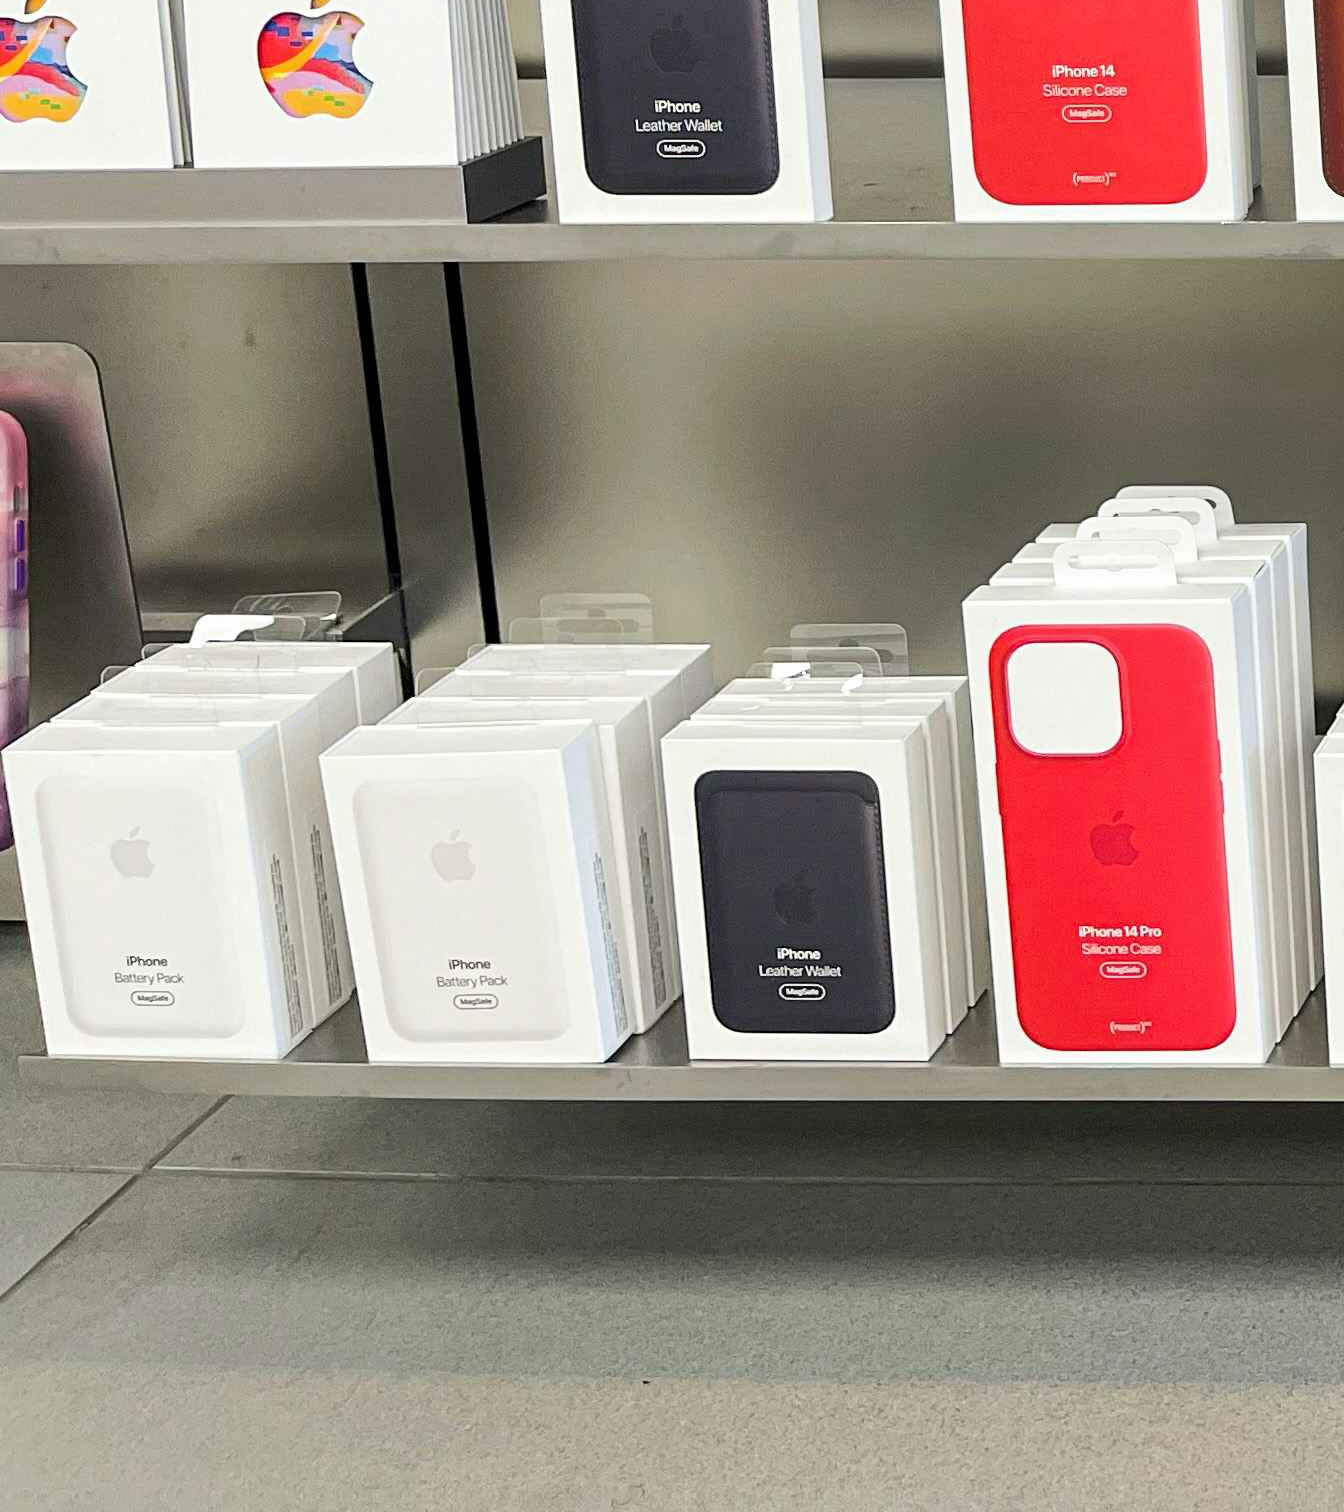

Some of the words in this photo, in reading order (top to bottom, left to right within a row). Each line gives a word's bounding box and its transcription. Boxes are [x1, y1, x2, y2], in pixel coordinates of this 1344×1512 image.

[1052, 65, 1098, 78] iPhone
[1100, 65, 1115, 77] 14
[1043, 84, 1093, 96] Silicone
[1095, 84, 1127, 96] Case
[655, 100, 700, 112] iPhone
[635, 120, 682, 132] Leather
[684, 120, 722, 132] Wallet
[1079, 926, 1122, 937] iPhone
[1124, 926, 1138, 937] 14
[1140, 926, 1161, 937] Pro
[777, 948, 820, 959] iPhone
[1082, 944, 1128, 954] Silicone
[1130, 944, 1161, 954] Case
[127, 956, 168, 966] iPhone
[449, 959, 491, 969] iPhone
[759, 966, 803, 977] Leather
[805, 966, 841, 977] Wallet
[115, 972, 155, 985] Battery
[157, 973, 184, 984] Pack
[437, 976, 477, 988] Battery
[480, 976, 508, 985] Pack
